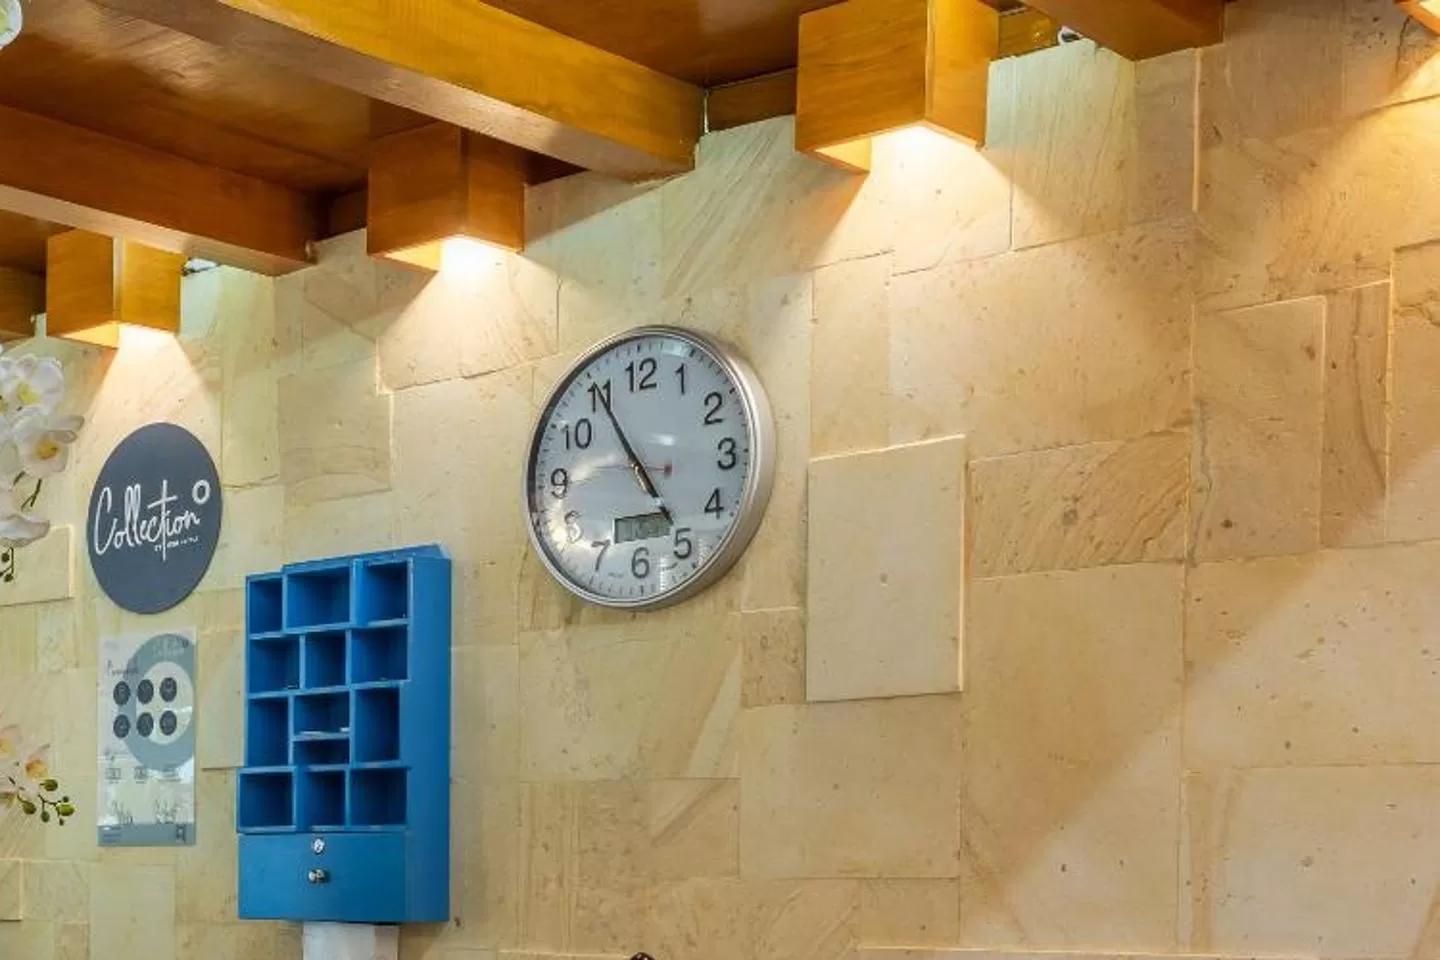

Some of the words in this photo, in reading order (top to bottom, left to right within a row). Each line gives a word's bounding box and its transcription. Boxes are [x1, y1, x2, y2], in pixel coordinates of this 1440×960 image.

[625, 357, 658, 393] 12
[675, 363, 686, 395] 1
[588, 378, 611, 413] 11
[703, 391, 723, 426] 2
[562, 418, 593, 451] 10
[717, 437, 737, 471] 3
[550, 467, 569, 499] 9
[704, 488, 724, 519] 4
[93, 479, 201, 562] Collection
[564, 510, 583, 542] 8
[591, 540, 610, 572] 7
[673, 528, 692, 559] 5
[631, 547, 651, 579] 6
